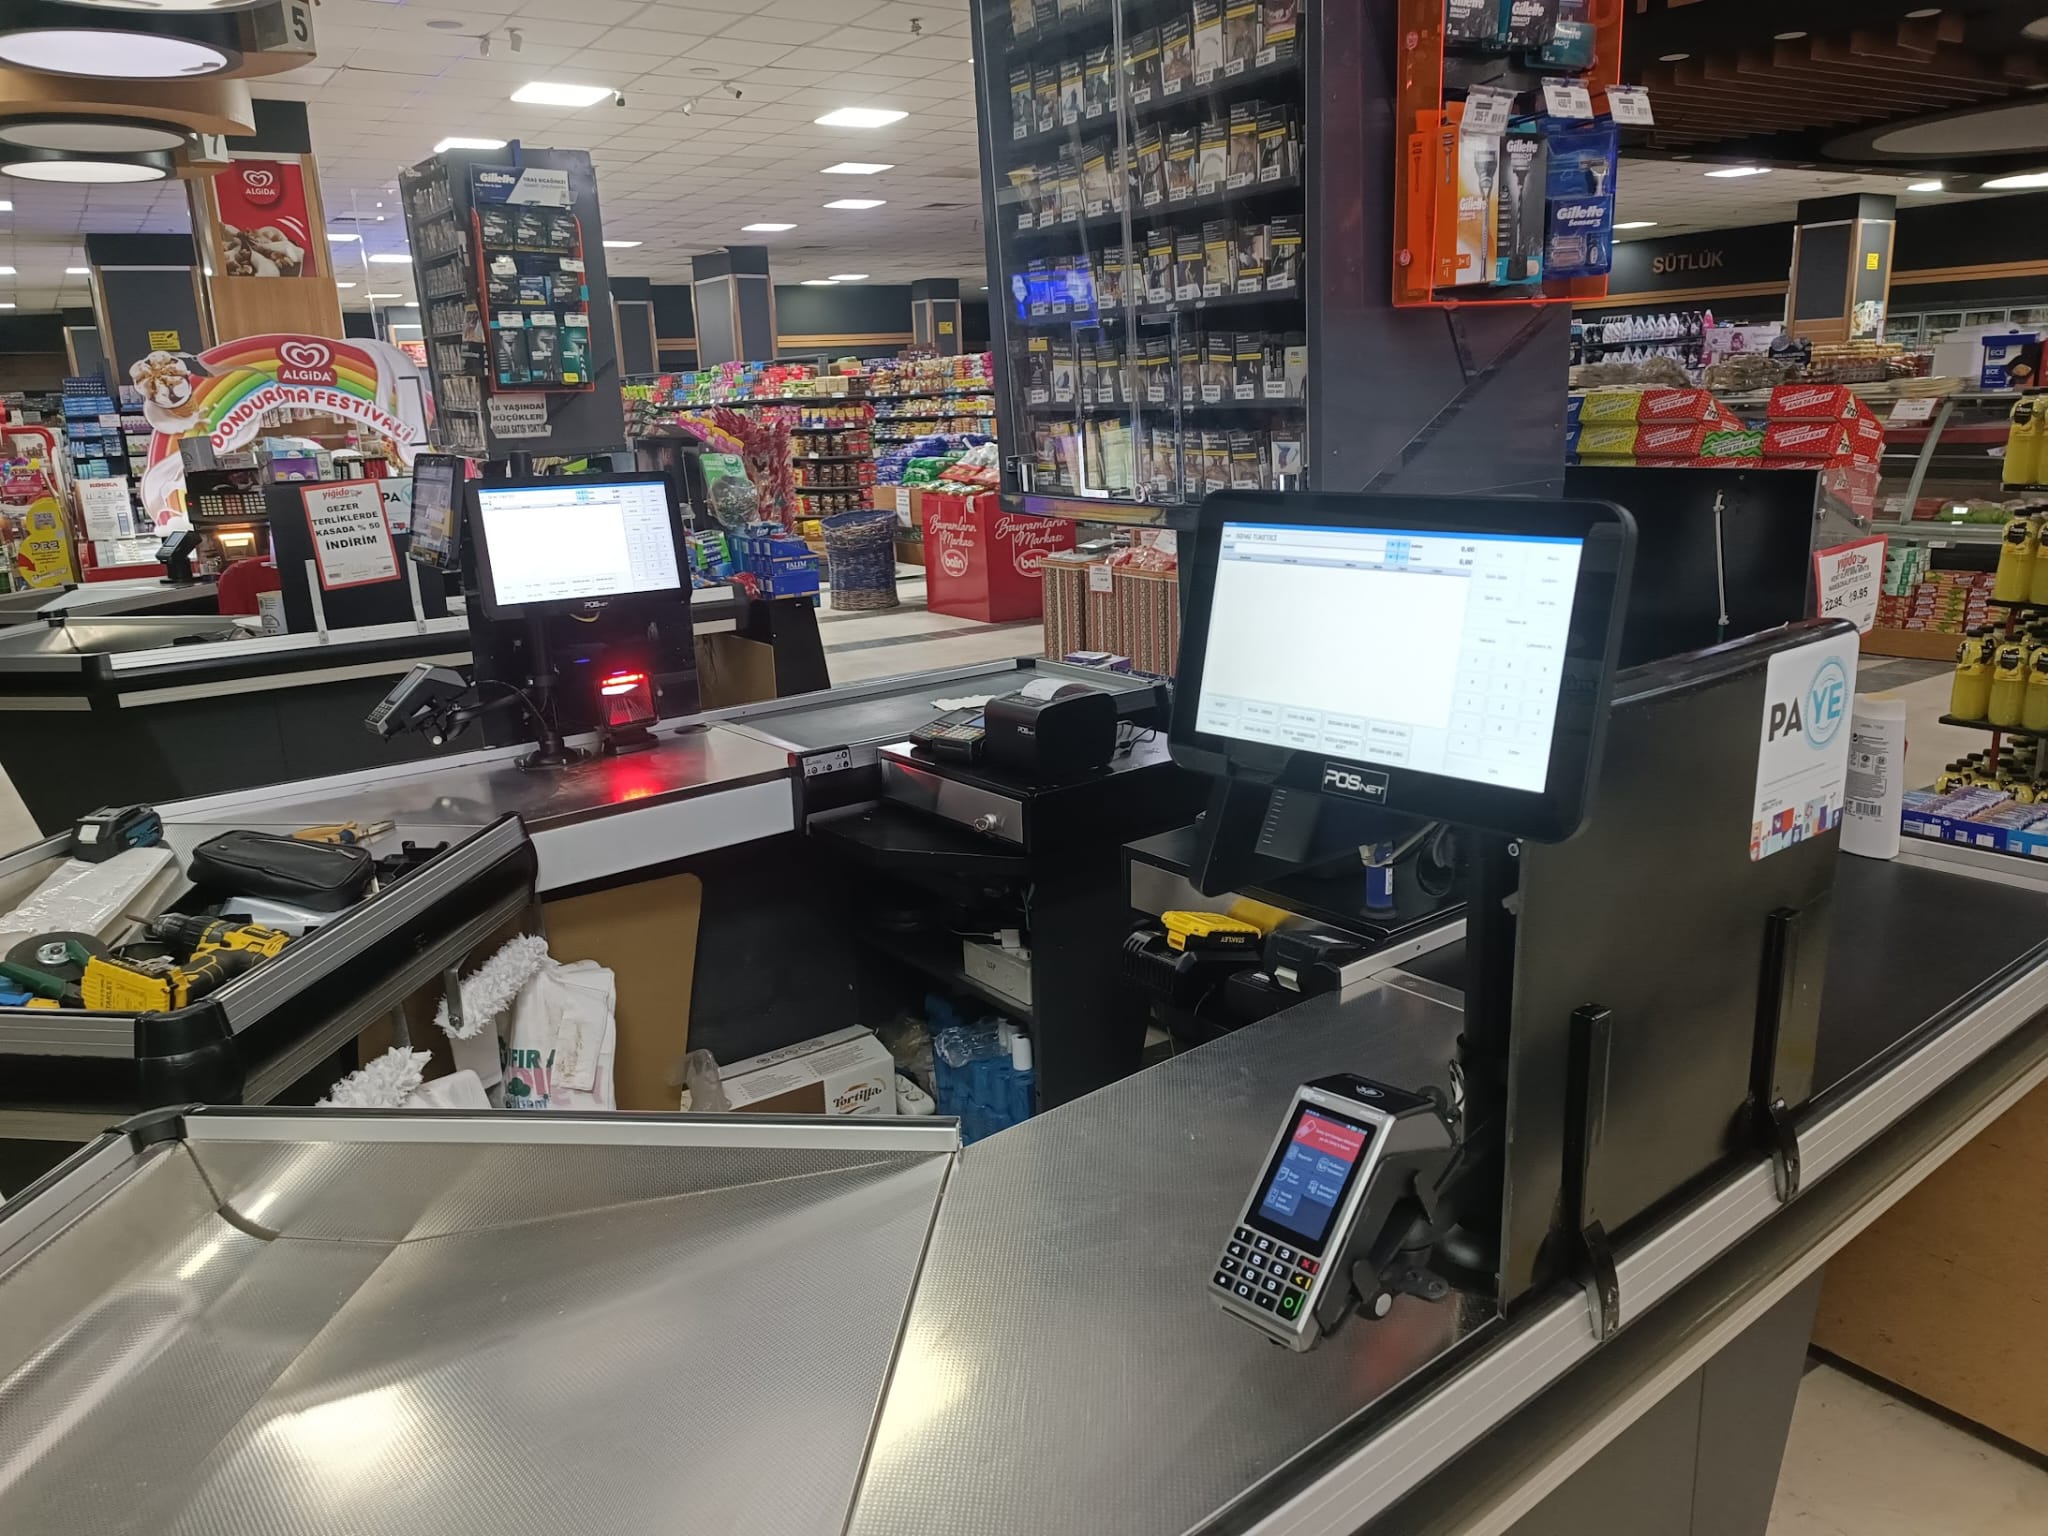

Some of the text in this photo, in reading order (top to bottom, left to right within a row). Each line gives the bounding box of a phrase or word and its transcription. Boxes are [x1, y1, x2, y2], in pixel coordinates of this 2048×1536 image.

[1512, 1, 1544, 17] Gillette
[291, 6, 308, 42] 5
[212, 134, 219, 155] 7
[1506, 139, 1538, 153] Gillette
[1556, 205, 1604, 220] Gillette
[1652, 249, 1723, 273] SÜTLÜK
[1990, 349, 2005, 357] ECE
[1986, 368, 2000, 376] ECE
[210, 386, 309, 448] DONDURMA
[326, 503, 360, 513] GEZER
[313, 510, 379, 526] TERLİKLERDE
[315, 525, 356, 537] KASADA
[326, 535, 378, 551] İNDİRİM
[786, 561, 807, 569] FALIM
[944, 555, 964, 569] balin
[833, 1085, 883, 1109] Tortilla
[1239, 1231, 1290, 1260] 1 2 3
[1231, 1245, 1283, 1276] 4 5 6
[1225, 1260, 1276, 1291] 7 8 9
[1238, 1285, 1248, 1295] 0
